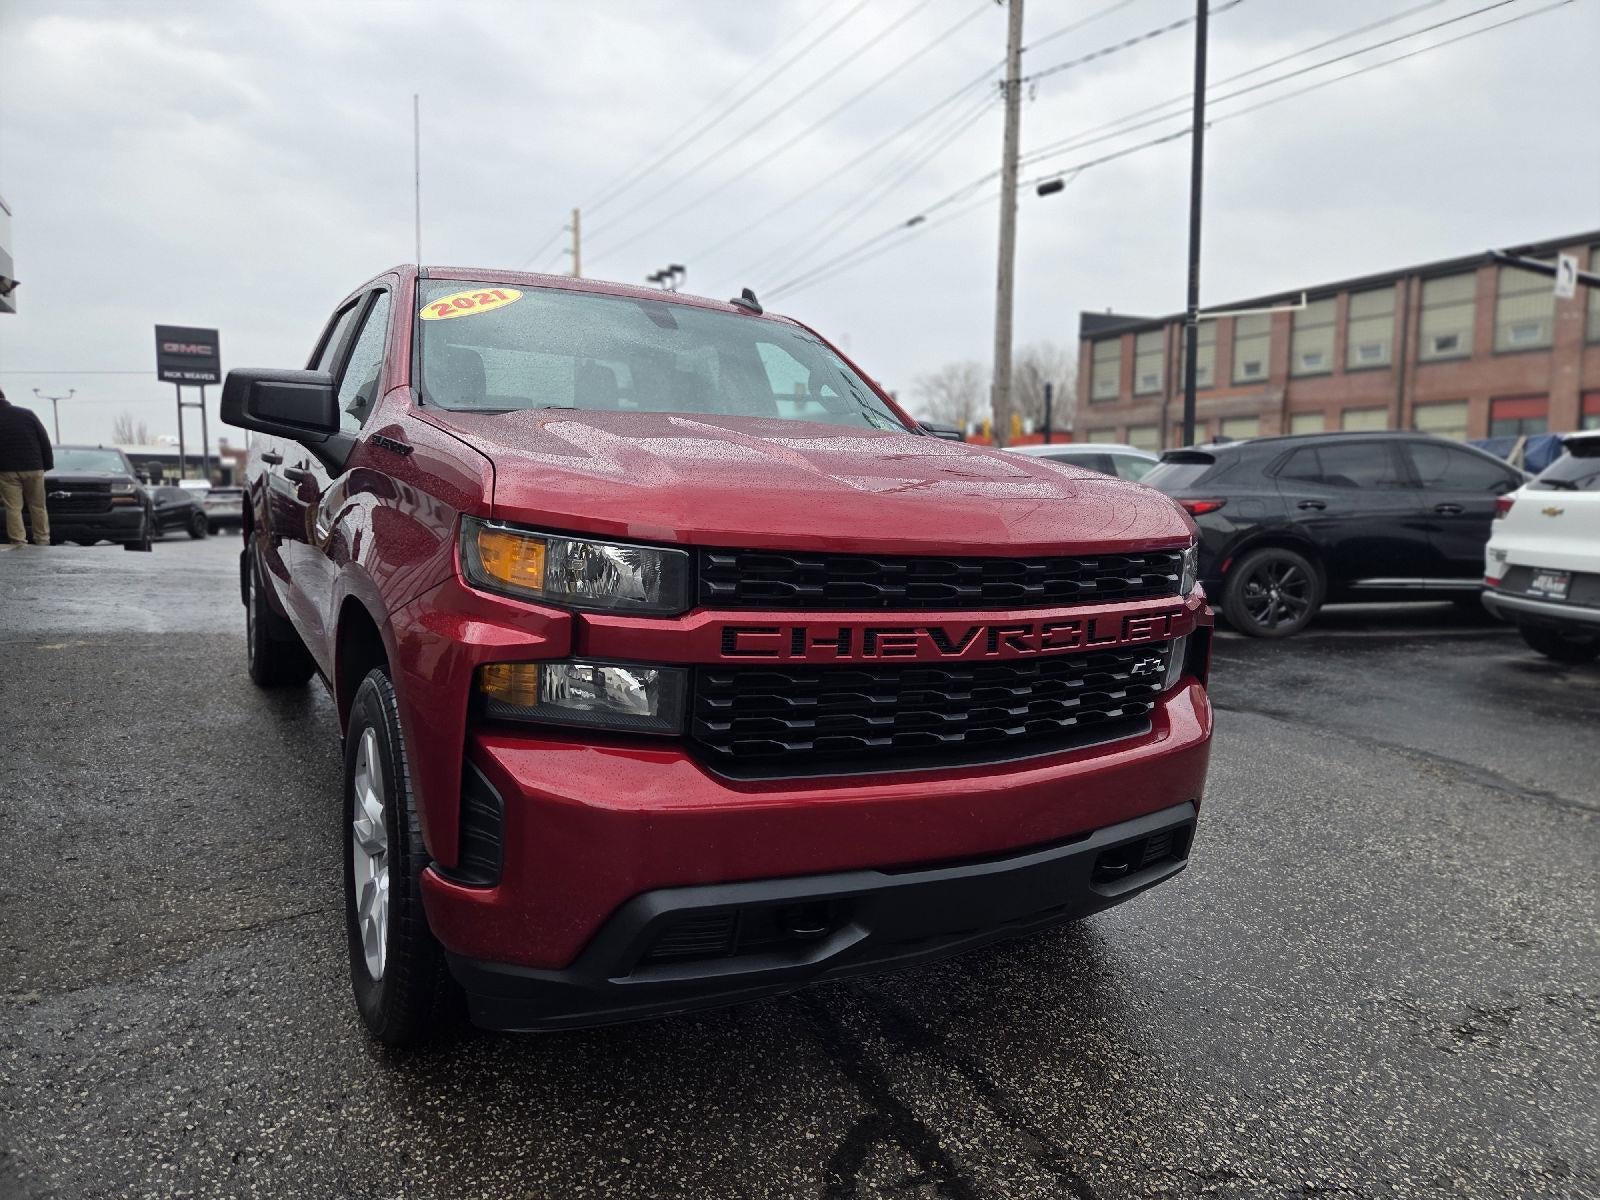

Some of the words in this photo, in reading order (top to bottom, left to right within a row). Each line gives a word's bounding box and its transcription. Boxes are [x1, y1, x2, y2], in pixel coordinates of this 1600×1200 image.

[431, 290, 509, 317] 2021
[163, 342, 212, 355] GMC
[720, 609, 1183, 660] CHEVROLET
